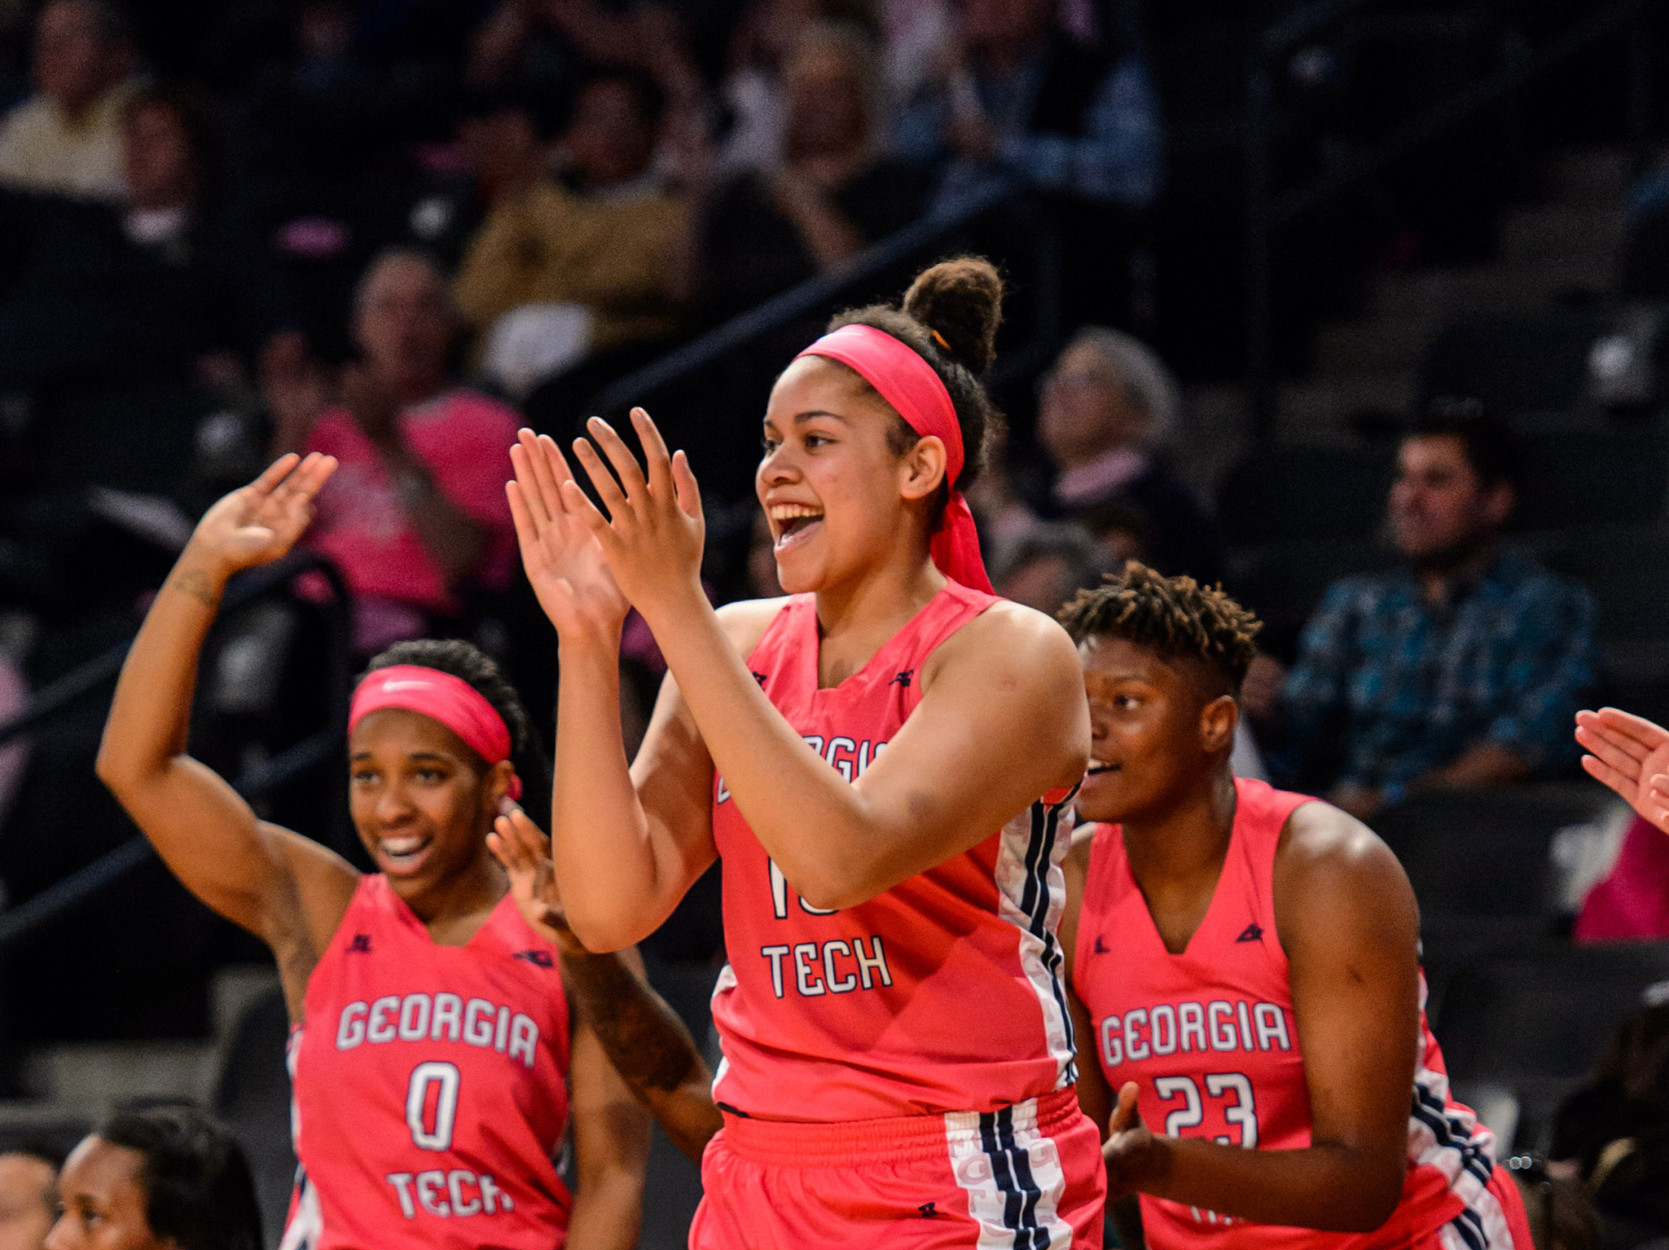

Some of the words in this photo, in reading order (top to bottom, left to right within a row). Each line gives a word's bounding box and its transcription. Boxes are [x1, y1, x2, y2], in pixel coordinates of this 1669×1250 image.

[760, 935, 894, 999] TECH
[335, 992, 540, 1068] GEORGIA
[1101, 1000, 1292, 1068] GEORGIA
[405, 1060, 462, 1152] 0
[1154, 1072, 1259, 1150] 23
[385, 1170, 515, 1220] TECH
